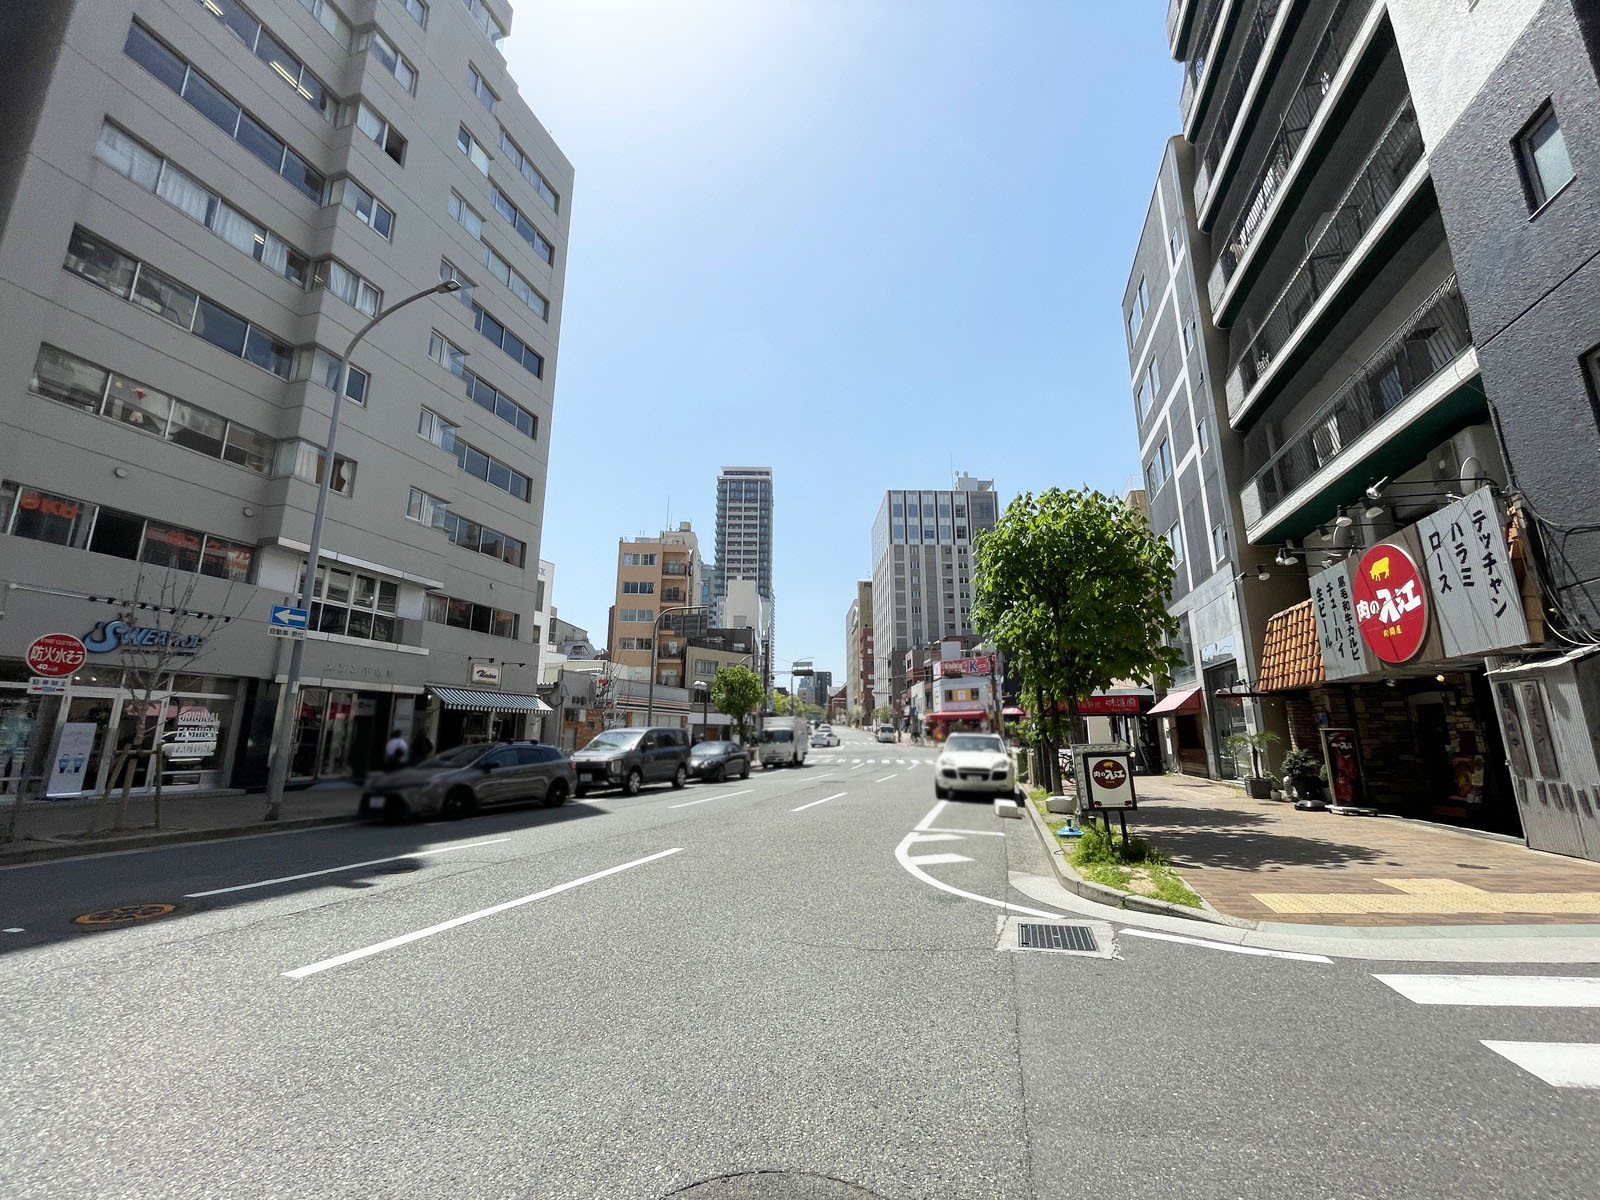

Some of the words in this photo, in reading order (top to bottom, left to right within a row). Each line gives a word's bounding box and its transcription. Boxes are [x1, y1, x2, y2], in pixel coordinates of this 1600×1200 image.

[1428, 531, 1452, 594] ロース
[1451, 522, 1474, 587] ハラミ
[1472, 509, 1507, 619] テッチャン
[1356, 579, 1422, 624] 肉の入江
[30, 645, 84, 665] 防火水そう
[1093, 769, 1126, 780] 肉の入江
